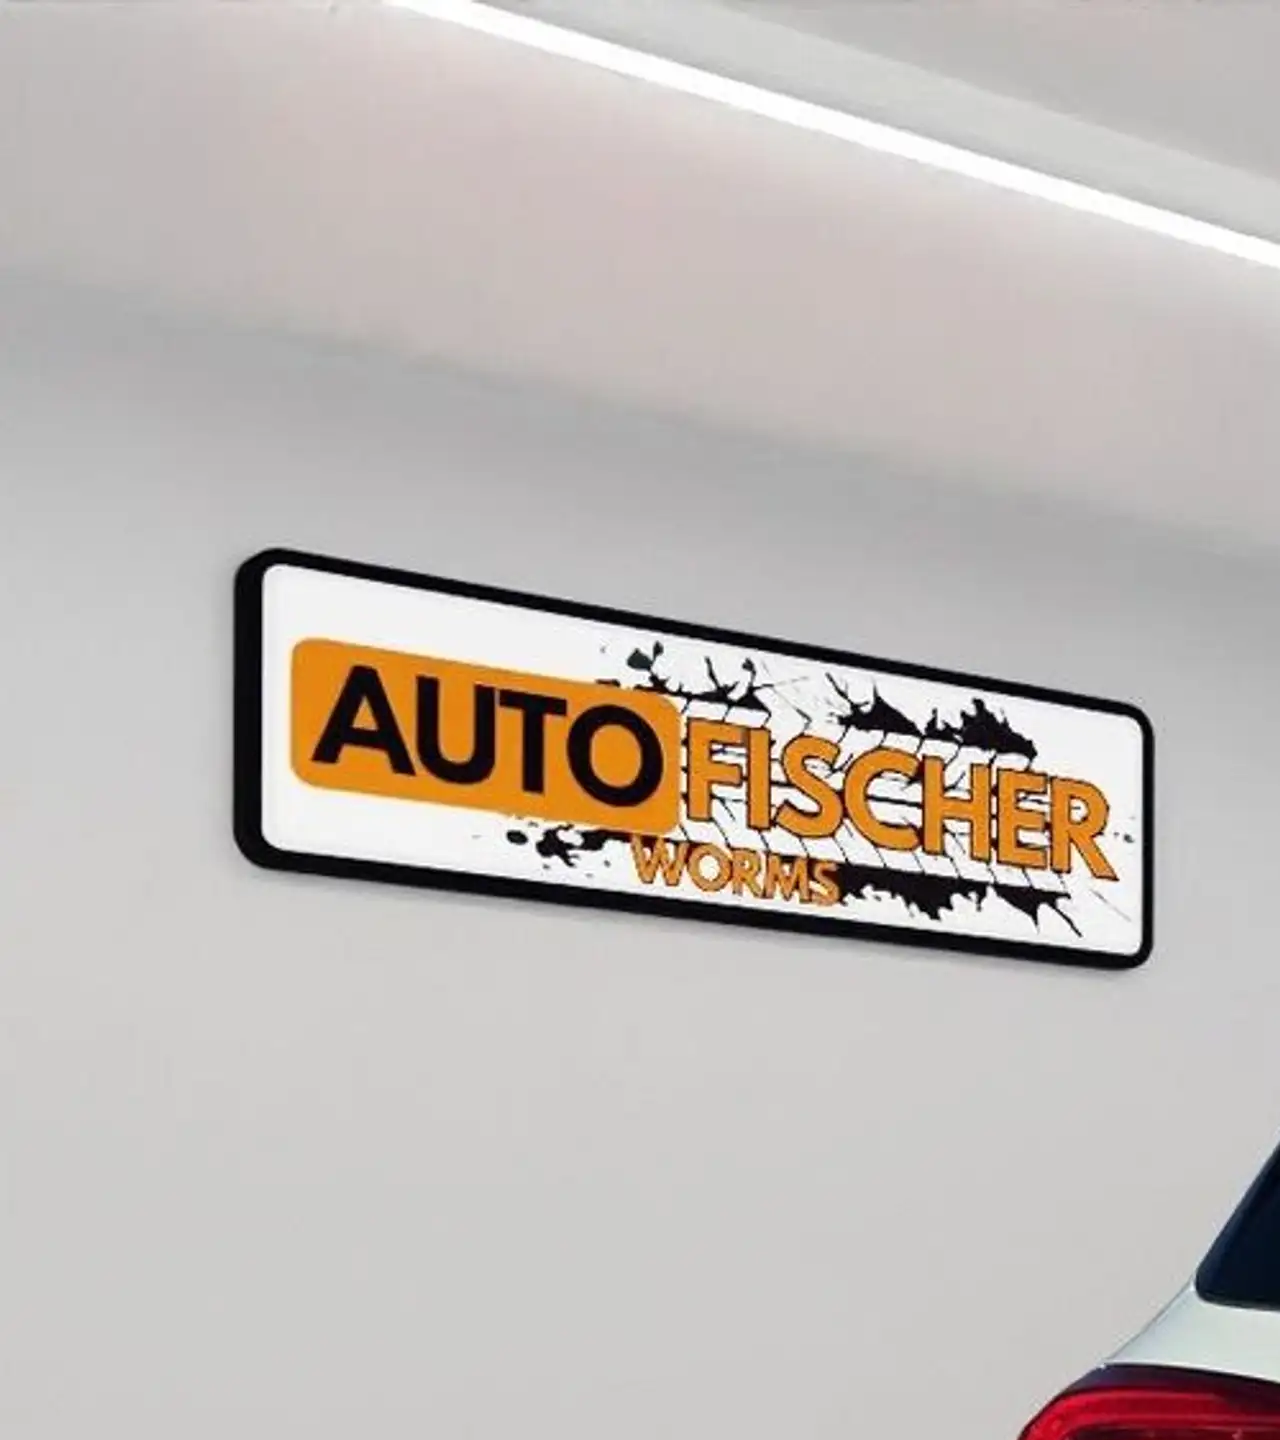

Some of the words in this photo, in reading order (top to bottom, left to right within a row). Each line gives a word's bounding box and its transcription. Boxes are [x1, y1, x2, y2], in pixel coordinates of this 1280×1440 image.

[311, 665, 664, 808] AUTO
[687, 717, 1119, 881] FISCHER
[631, 837, 840, 905] WORMS
